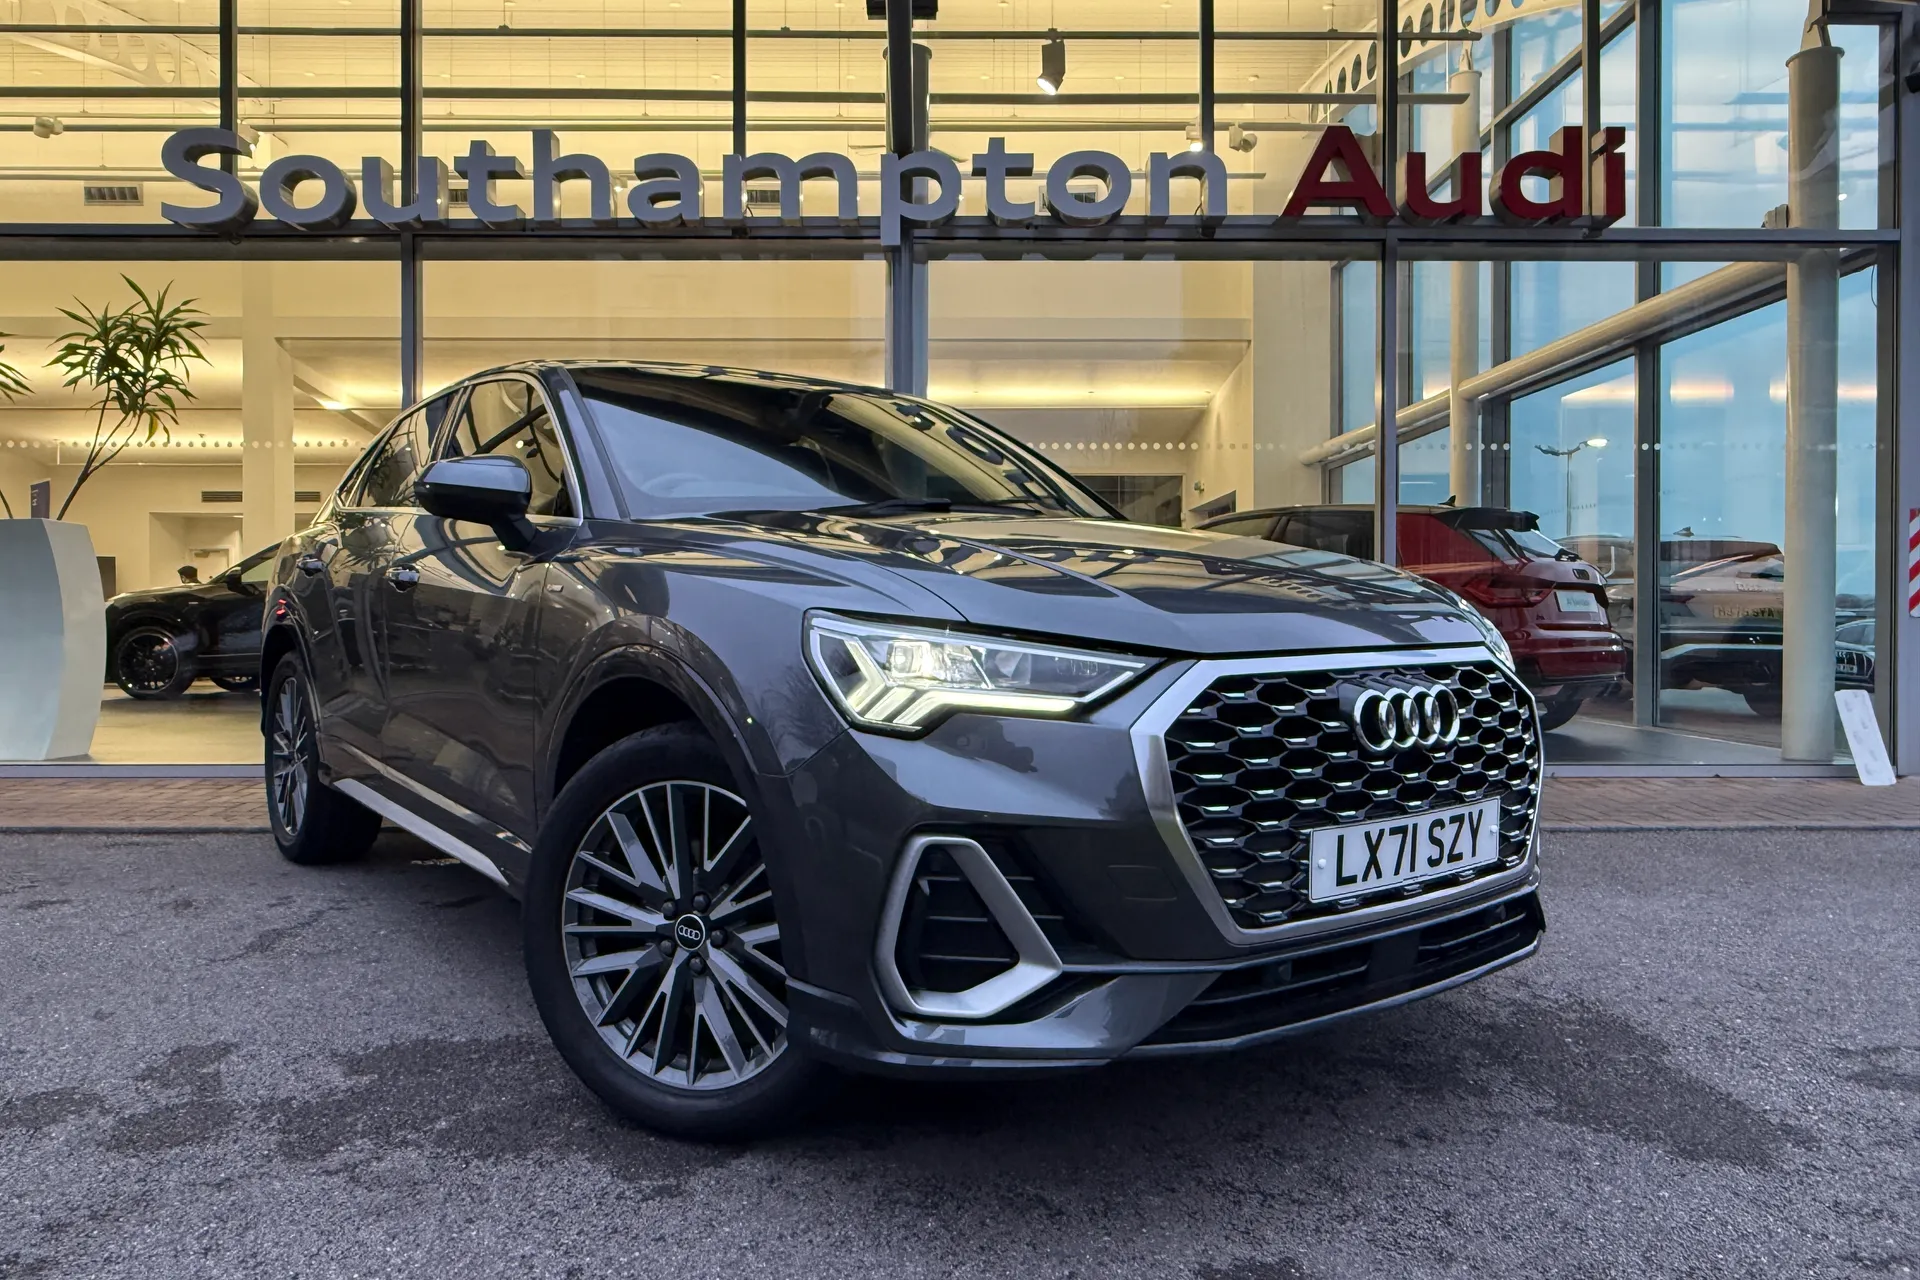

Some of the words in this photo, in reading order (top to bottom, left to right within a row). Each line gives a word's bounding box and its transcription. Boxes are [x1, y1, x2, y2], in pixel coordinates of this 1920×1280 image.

[160, 127, 1229, 246] Southampton
[1281, 125, 1626, 225] Audi
[1336, 822, 1419, 887] LX71
[1427, 808, 1484, 868] SZY
